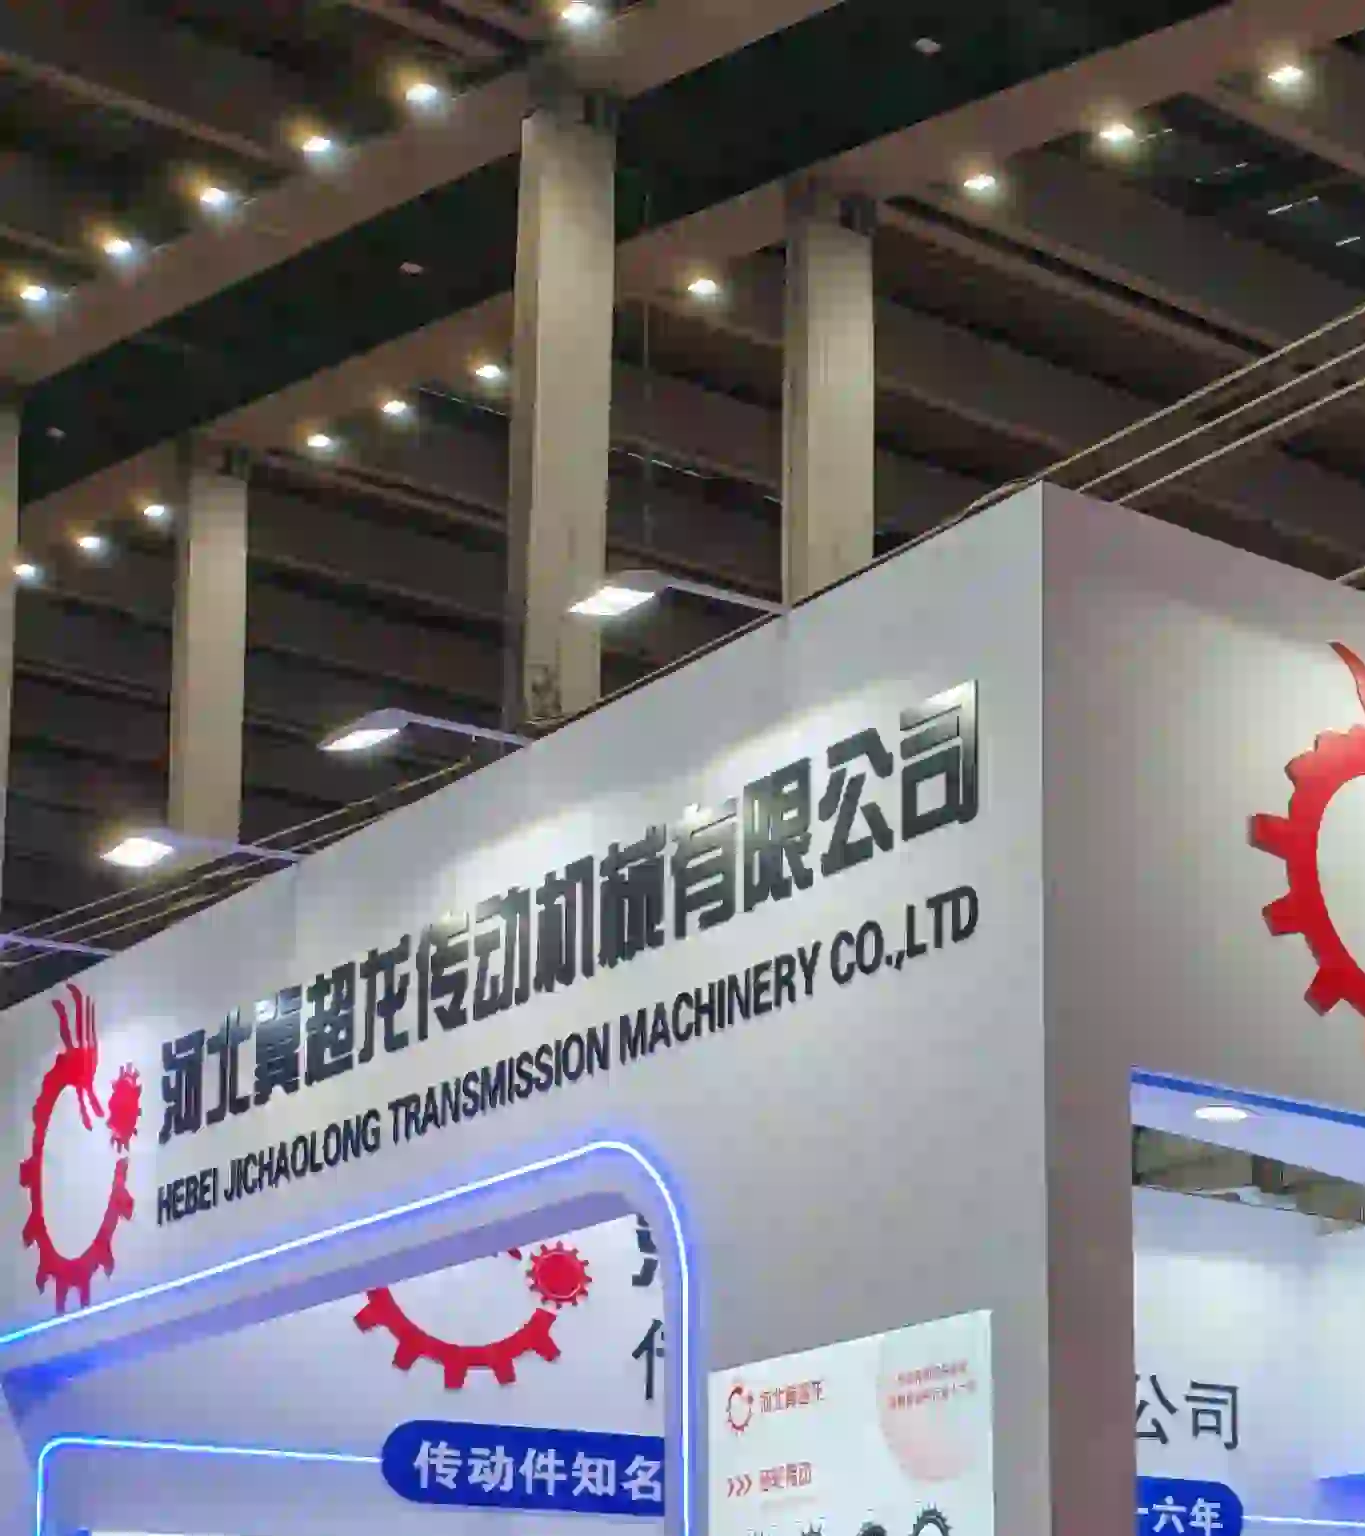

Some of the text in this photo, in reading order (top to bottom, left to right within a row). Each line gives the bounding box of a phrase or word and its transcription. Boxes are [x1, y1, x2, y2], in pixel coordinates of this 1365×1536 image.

[158, 677, 982, 1146] 河北冀超龙传动机械有限公司
[157, 1167, 218, 1227] HEBEI
[224, 1108, 380, 1202] JICHAOLONG
[388, 1021, 611, 1146] TRANSMISSION
[619, 940, 822, 1065] MACHINERY
[413, 1439, 662, 1502] 传动件知名
